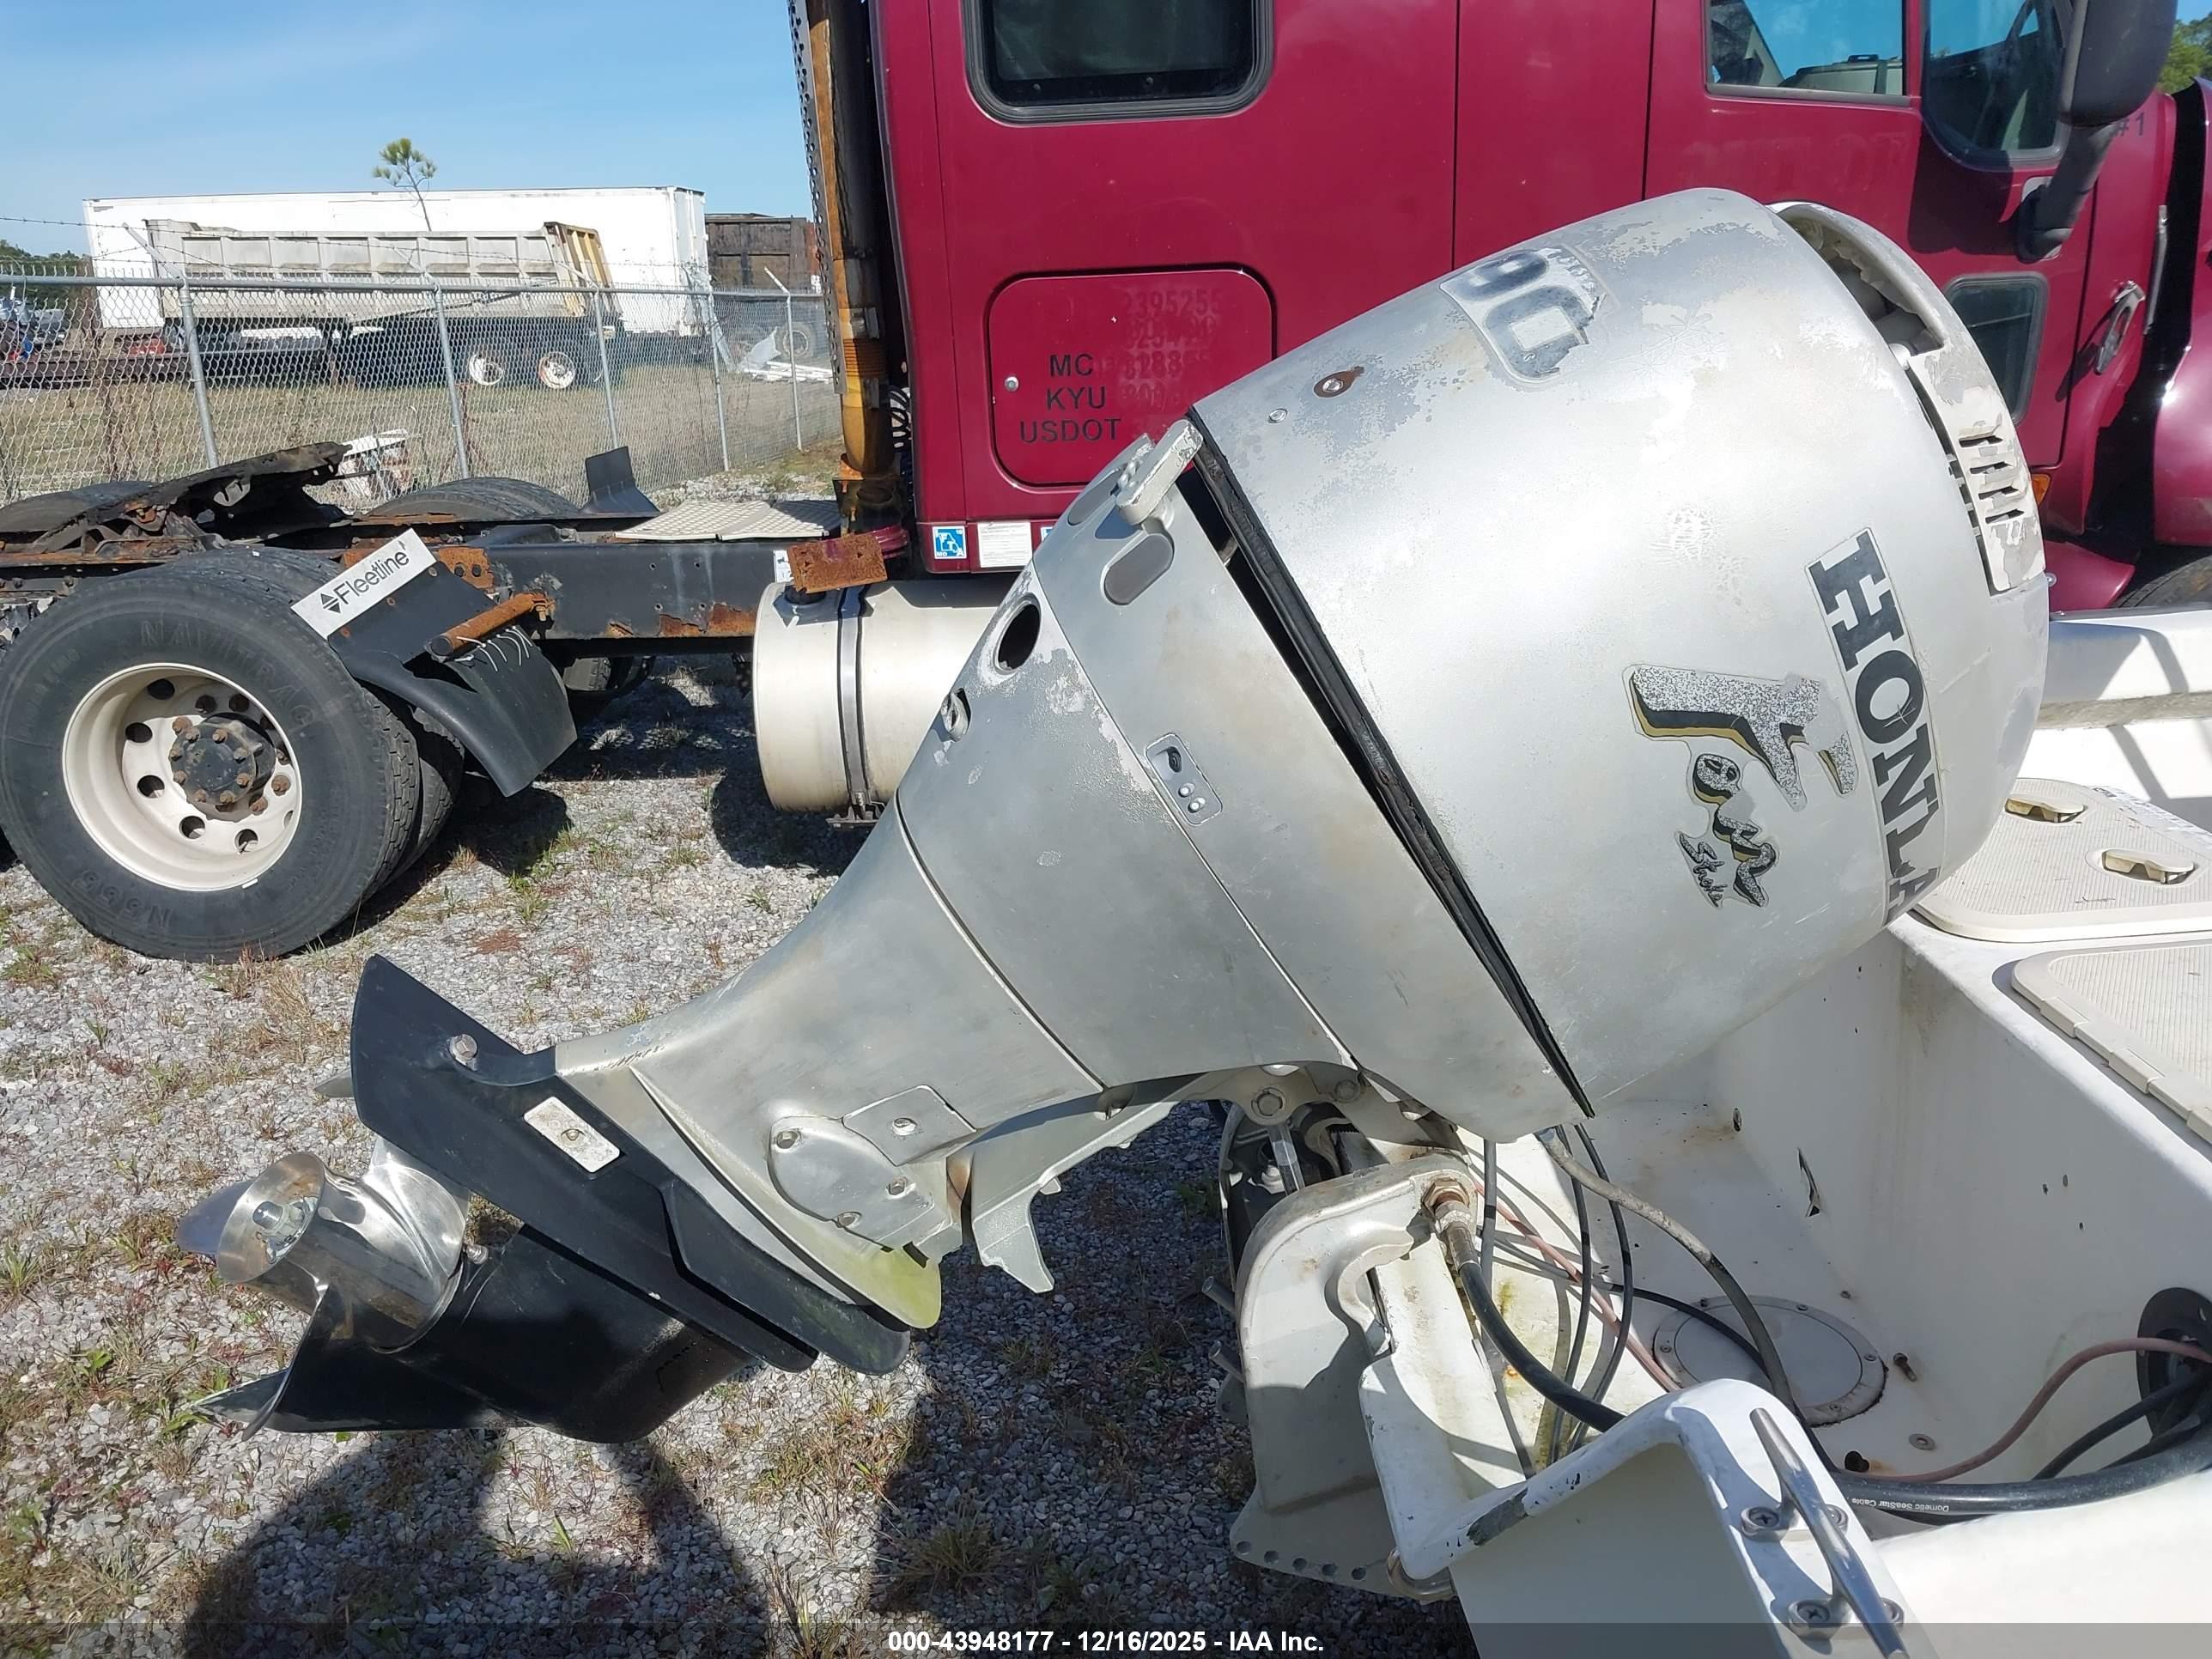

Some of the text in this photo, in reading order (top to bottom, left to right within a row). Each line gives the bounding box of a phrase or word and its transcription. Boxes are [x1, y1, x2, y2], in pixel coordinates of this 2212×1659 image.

[1049, 354, 1093, 377] MC
[1047, 386, 1106, 410] KYU
[1020, 418, 1121, 443] USDOT
[333, 551, 410, 605] Fleetline
[1851, 1498, 1876, 1507] Cable
[1879, 1500, 1913, 1510] SeaStar
